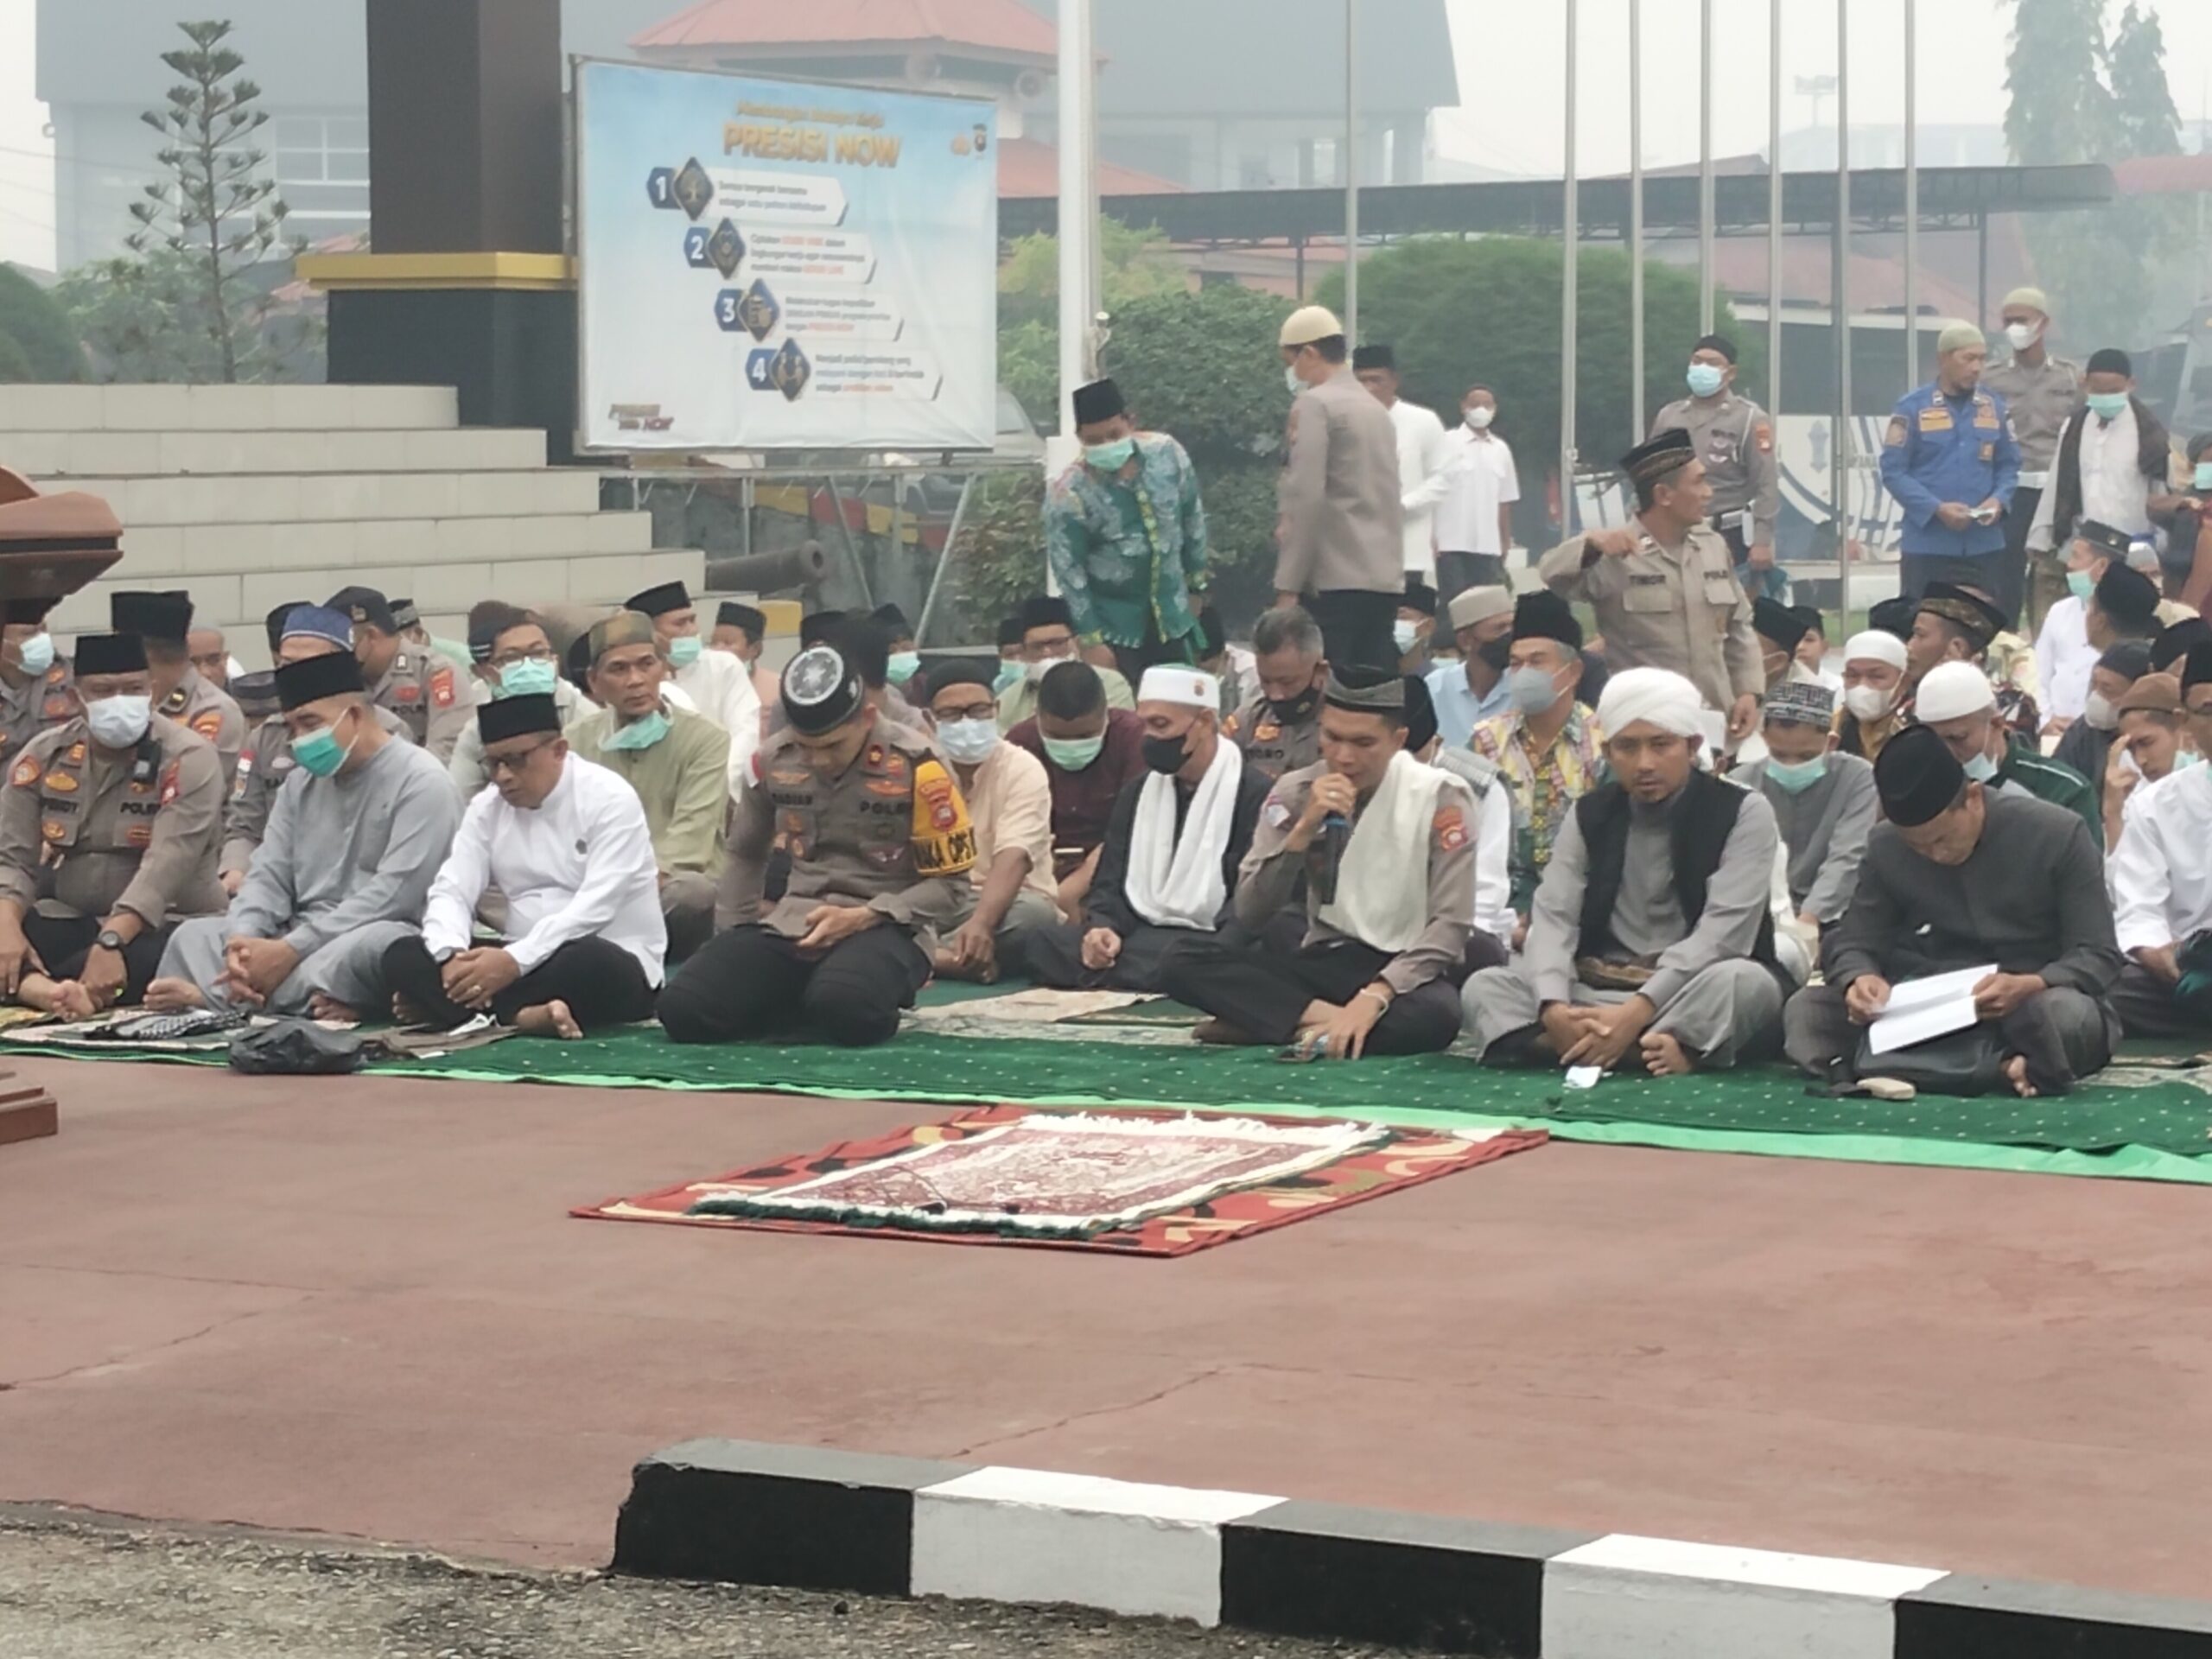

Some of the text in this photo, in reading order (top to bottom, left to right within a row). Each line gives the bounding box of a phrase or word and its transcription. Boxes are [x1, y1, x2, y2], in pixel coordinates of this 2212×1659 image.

[724, 124, 900, 168] PRESISI NOW
[655, 176, 667, 201] 1
[691, 235, 704, 259] 2
[722, 298, 735, 322] 3
[753, 358, 766, 383] 4
